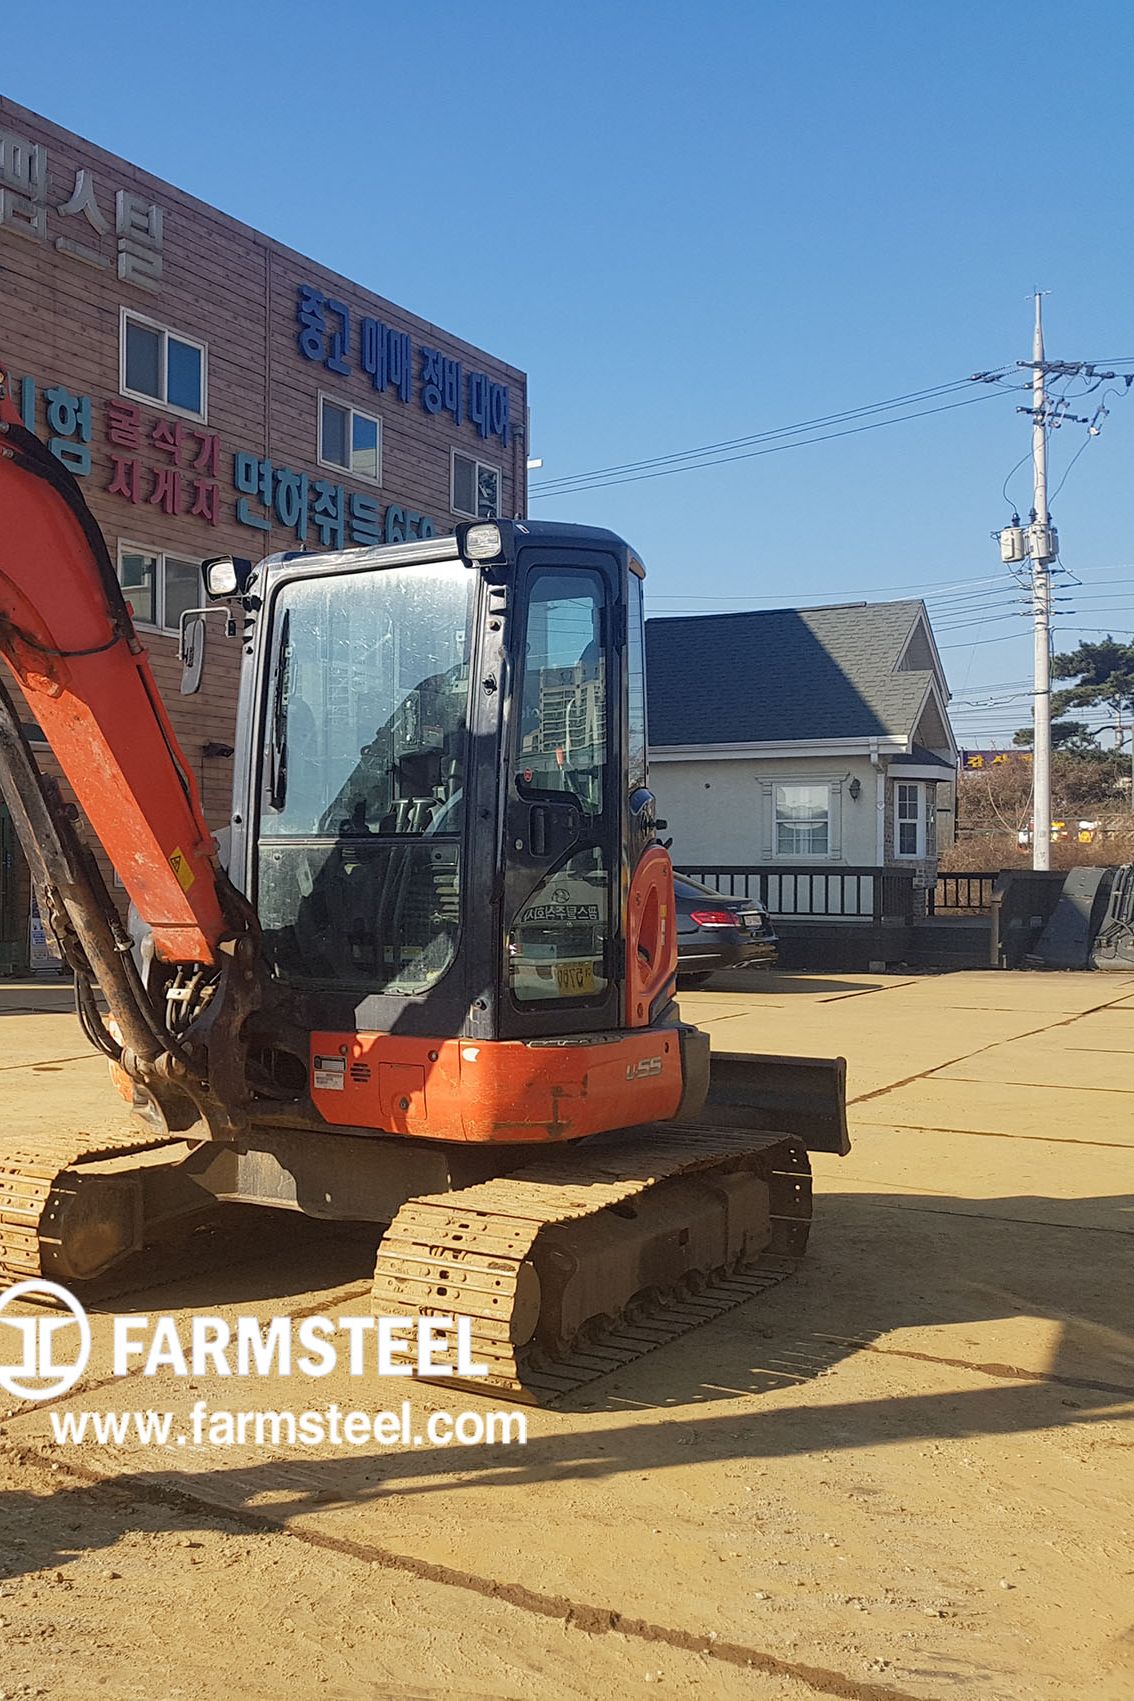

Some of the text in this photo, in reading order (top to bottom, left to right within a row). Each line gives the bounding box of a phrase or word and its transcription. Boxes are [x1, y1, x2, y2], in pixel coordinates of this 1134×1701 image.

[297, 284, 510, 449] 중고 매매 정비 대여
[107, 400, 221, 477] 굴삭기
